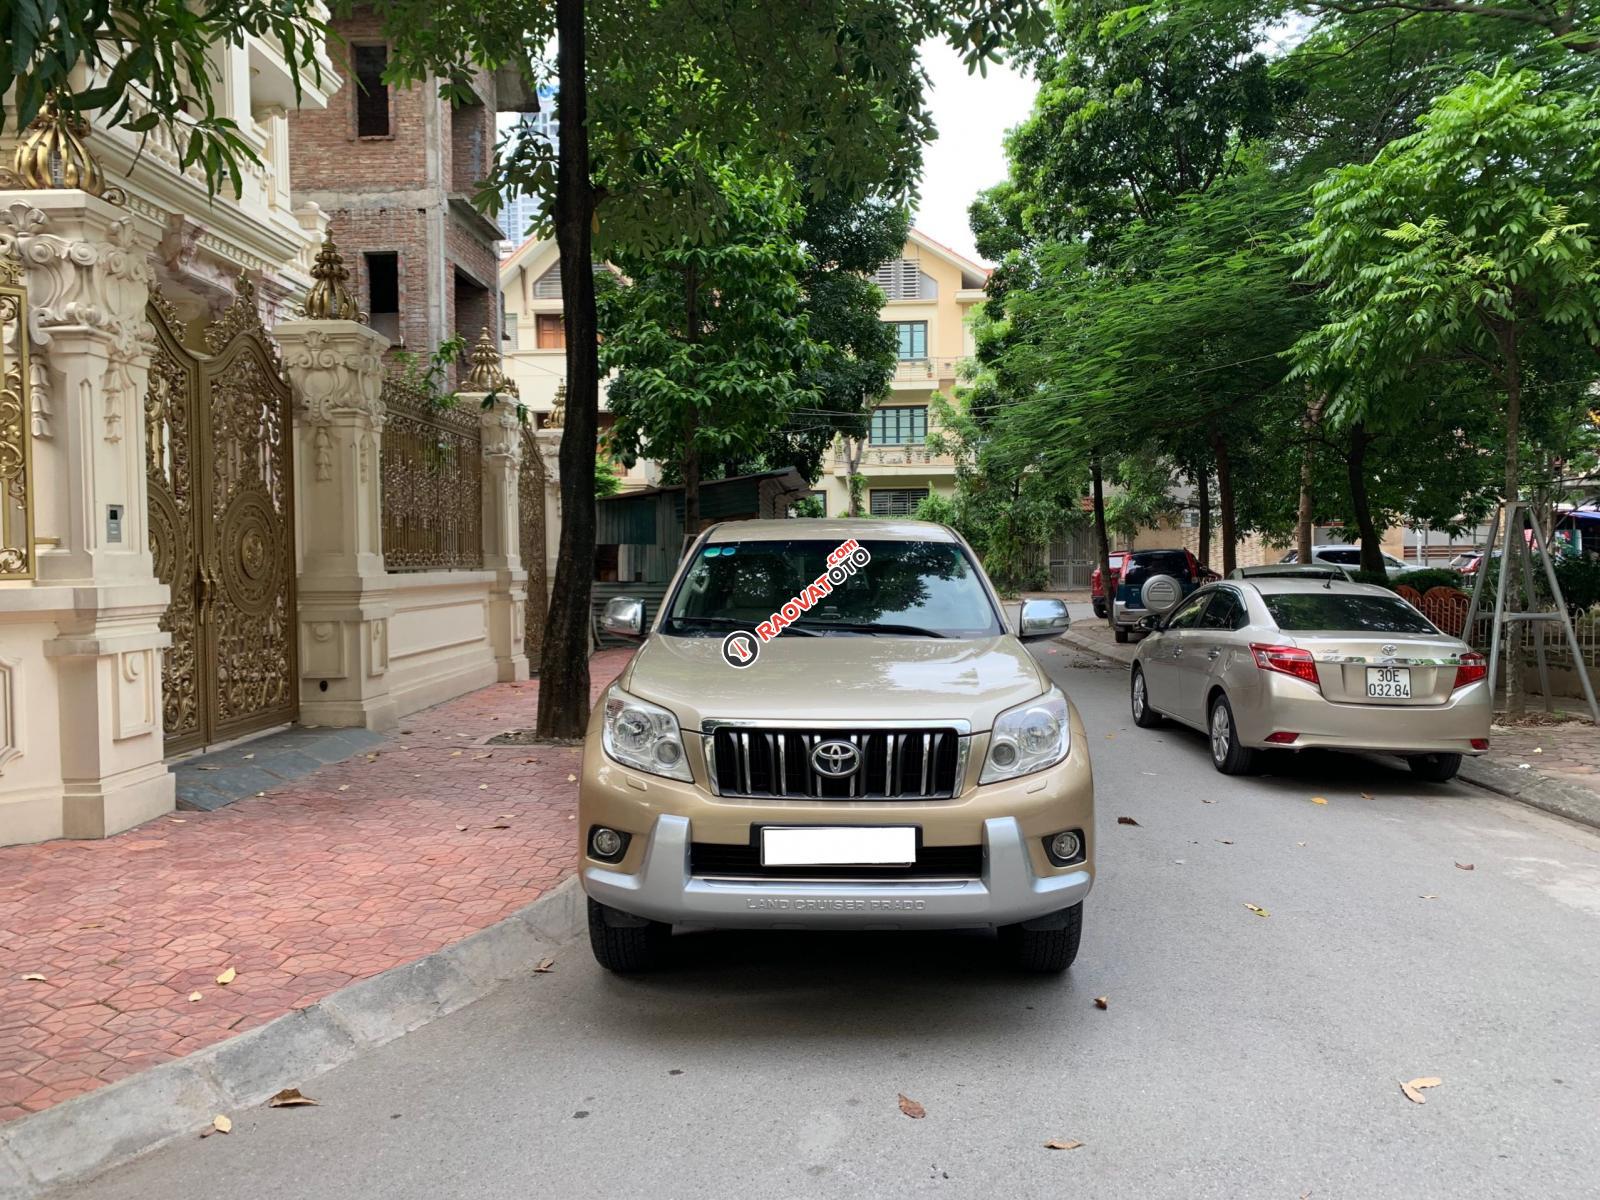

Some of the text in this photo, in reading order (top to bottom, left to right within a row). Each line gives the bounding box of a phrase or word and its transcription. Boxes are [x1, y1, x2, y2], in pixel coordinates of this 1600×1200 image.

[1377, 669, 1400, 682] 30E
[1369, 683, 1410, 697] 032.84
[747, 899, 927, 911] LAND CRUISER PRADO
